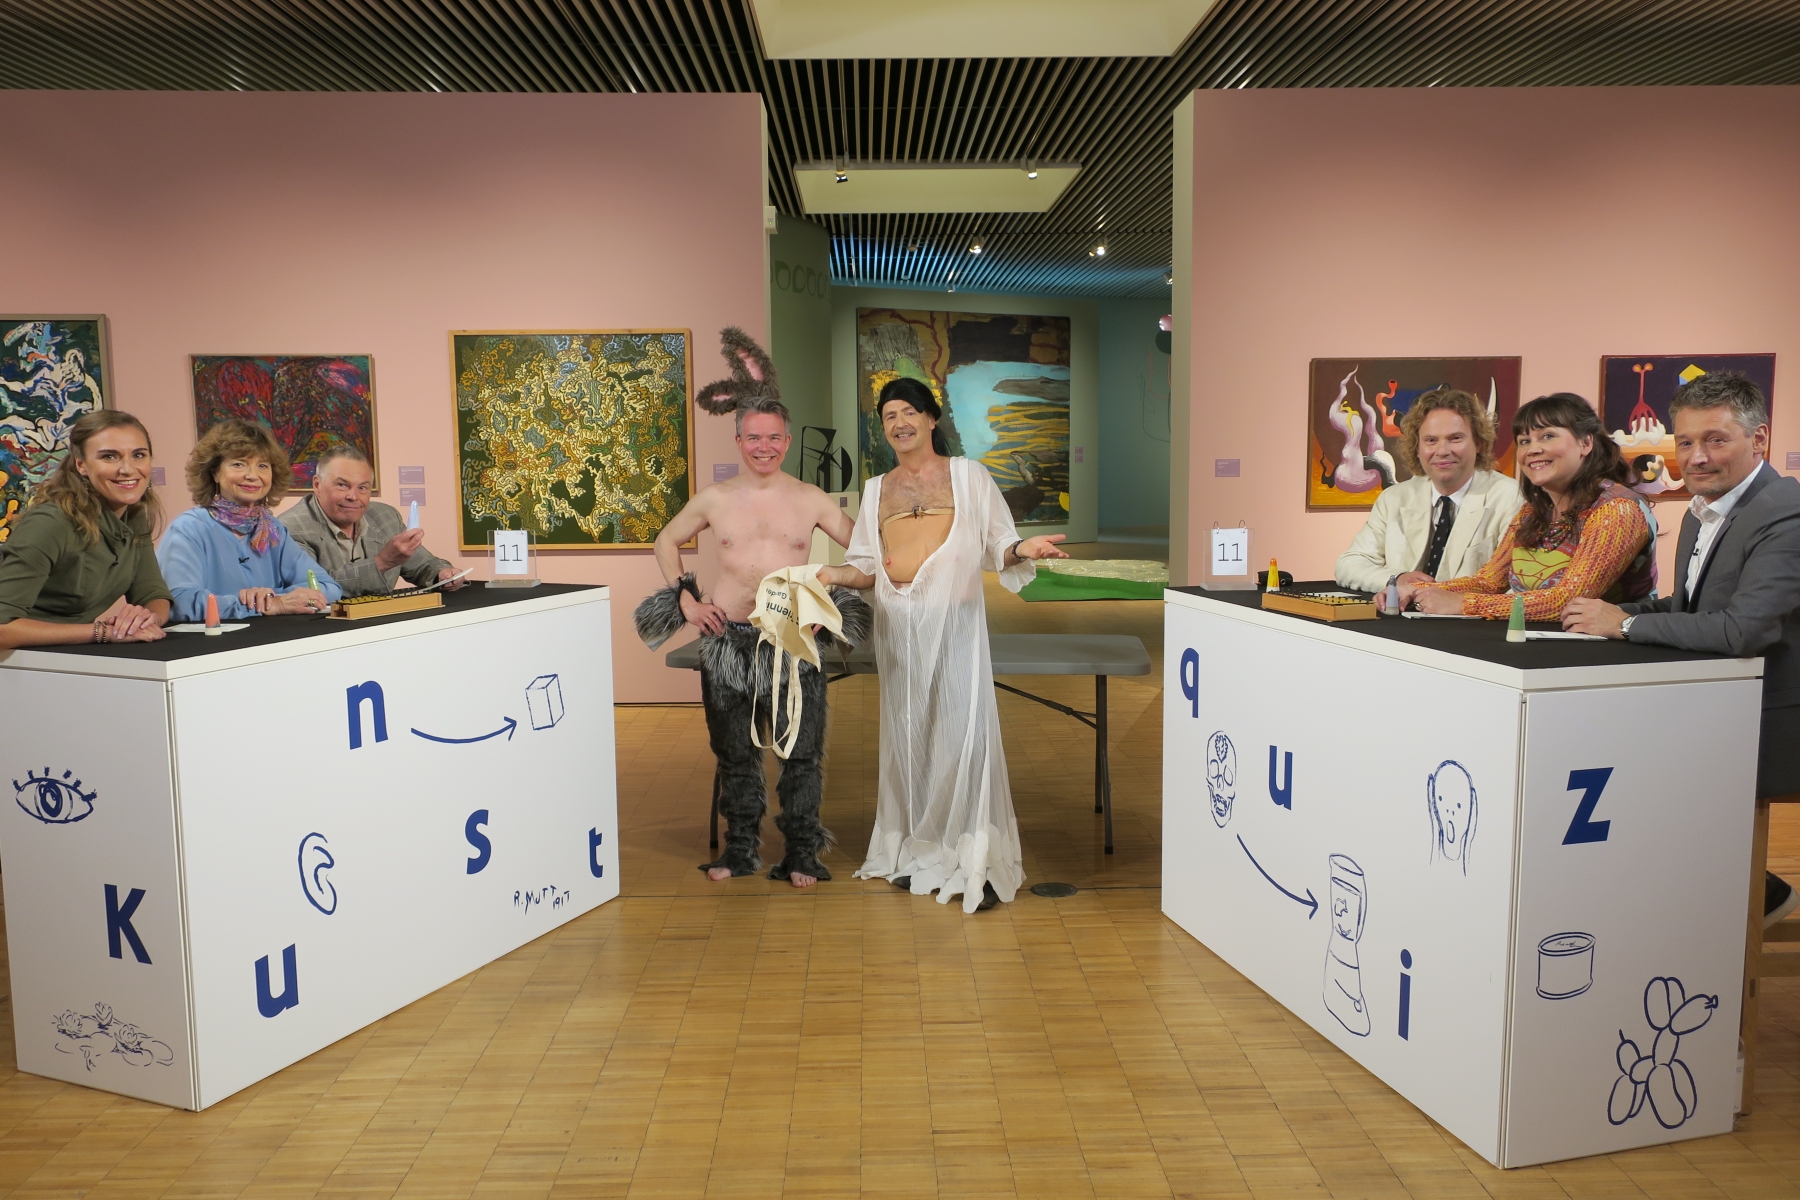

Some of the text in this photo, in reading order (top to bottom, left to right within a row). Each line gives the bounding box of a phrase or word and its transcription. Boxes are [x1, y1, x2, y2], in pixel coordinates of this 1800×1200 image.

[499, 544, 523, 562] 11
[1218, 543, 1243, 562] 11
[346, 680, 389, 750] n
[1180, 647, 1199, 719] q
[1268, 745, 1293, 810] u
[588, 826, 604, 878] t
[254, 944, 299, 1018] u
[1398, 949, 1413, 1041] i
